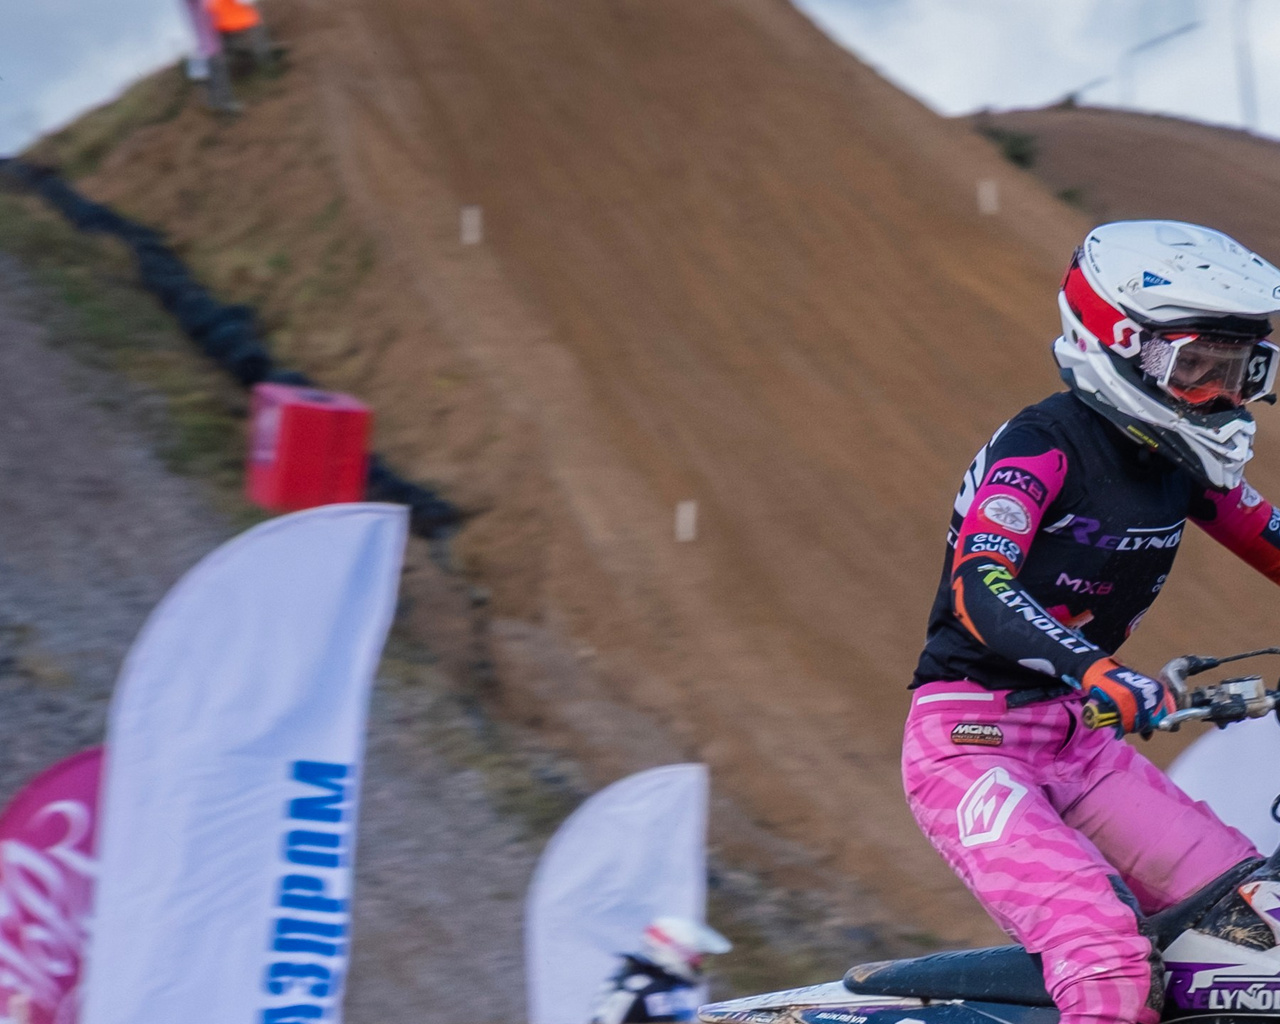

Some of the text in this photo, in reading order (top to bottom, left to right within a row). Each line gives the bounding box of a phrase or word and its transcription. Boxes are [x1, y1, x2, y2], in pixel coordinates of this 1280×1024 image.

[970, 543, 1017, 563] auto
[973, 533, 1021, 555] euro
[977, 564, 1092, 654] RELYNOLLI
[1116, 671, 1160, 710] KTM
